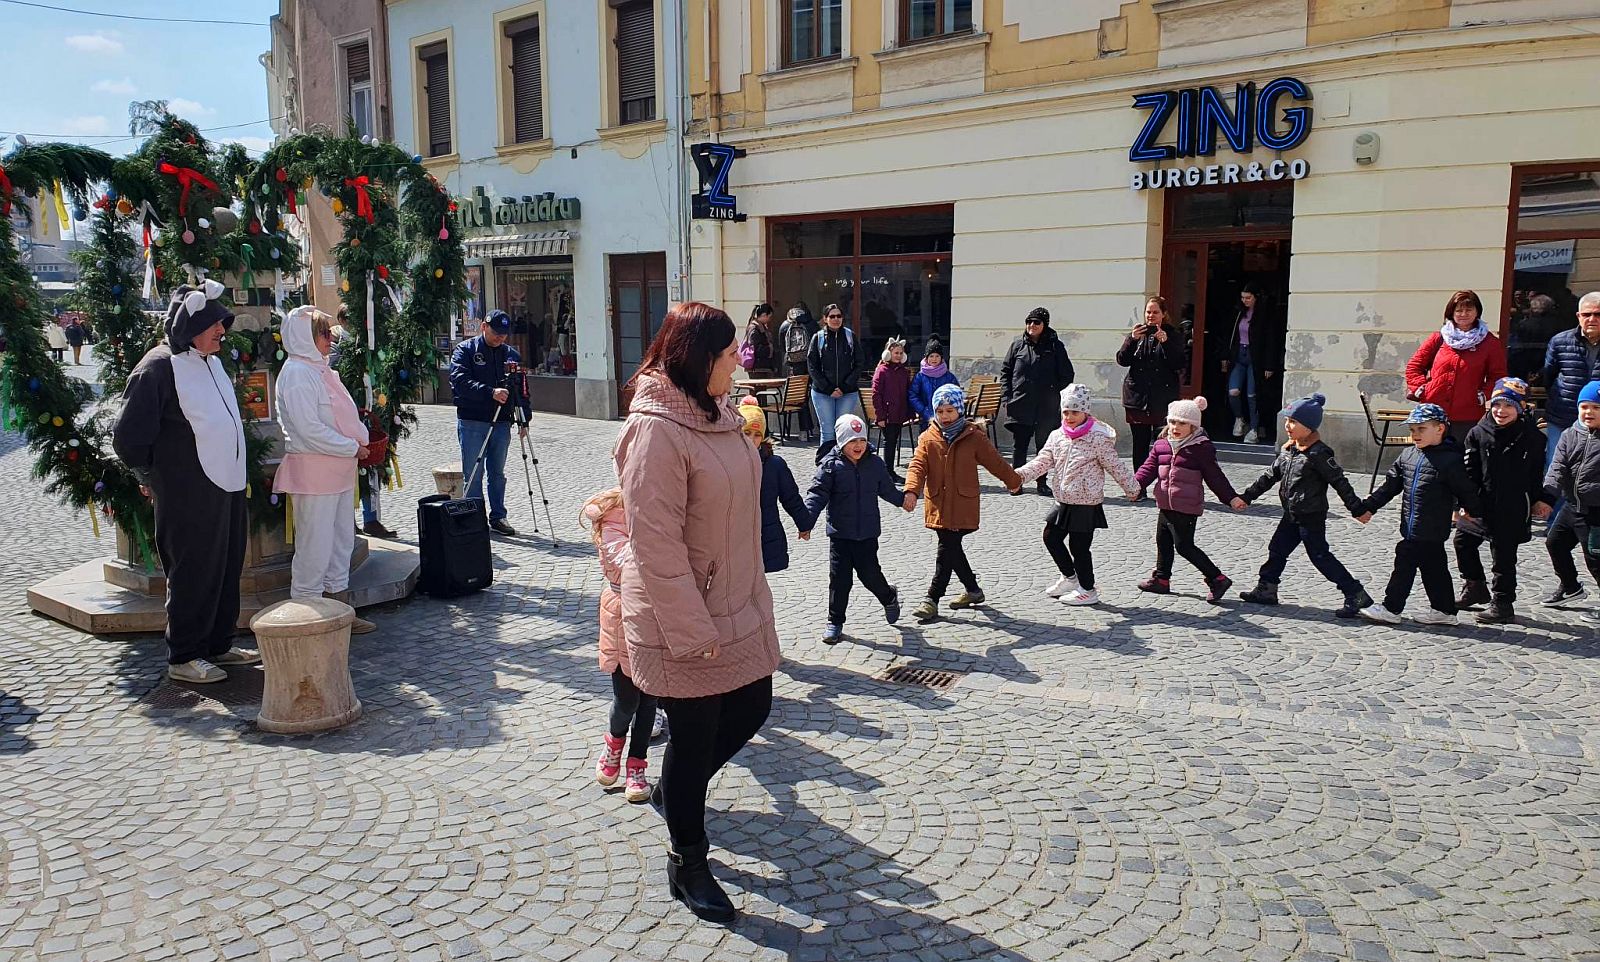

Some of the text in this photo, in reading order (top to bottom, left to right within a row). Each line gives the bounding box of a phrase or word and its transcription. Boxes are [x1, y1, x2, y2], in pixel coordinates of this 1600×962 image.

[1129, 76, 1314, 162] ZING
[1130, 158, 1311, 190] BURGER&CO
[709, 207, 735, 219] ZING
[850, 279, 871, 288] yur
[873, 276, 889, 285] life
